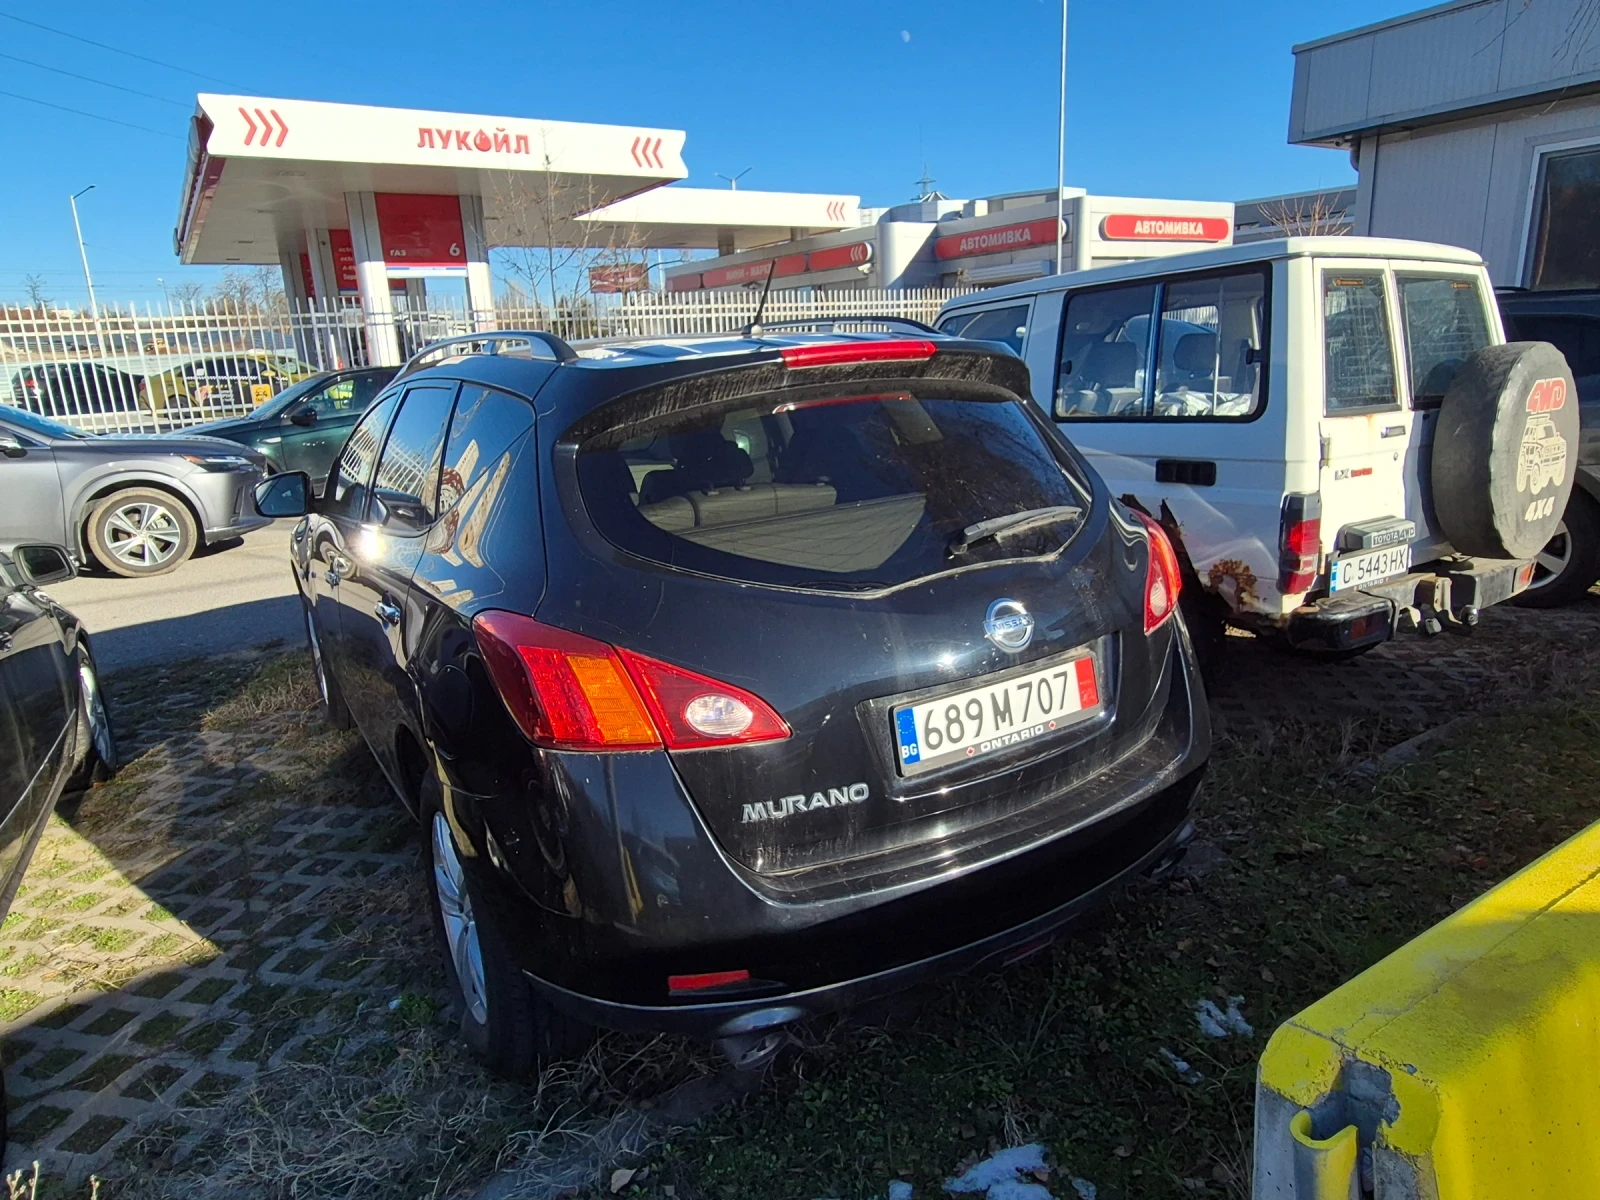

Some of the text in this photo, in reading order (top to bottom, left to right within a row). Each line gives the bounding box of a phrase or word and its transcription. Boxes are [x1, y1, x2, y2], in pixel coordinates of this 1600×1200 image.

[417, 127, 530, 155] ЛУКОЙЛ
[1134, 219, 1204, 236] АВТОМИВКА
[959, 227, 1032, 252] АВТОМИВКА
[390, 242, 461, 257] ГАЗ 6
[750, 263, 774, 277] МАРКЕ
[1526, 377, 1567, 414] 4WD
[1374, 531, 1398, 545] TOYOTA
[1359, 578, 1384, 589] ONTARIO
[992, 616, 1031, 631] NISSAN
[980, 724, 1044, 752] ONTARIO
[901, 743, 918, 759] BG
[741, 782, 870, 824] MURANO
